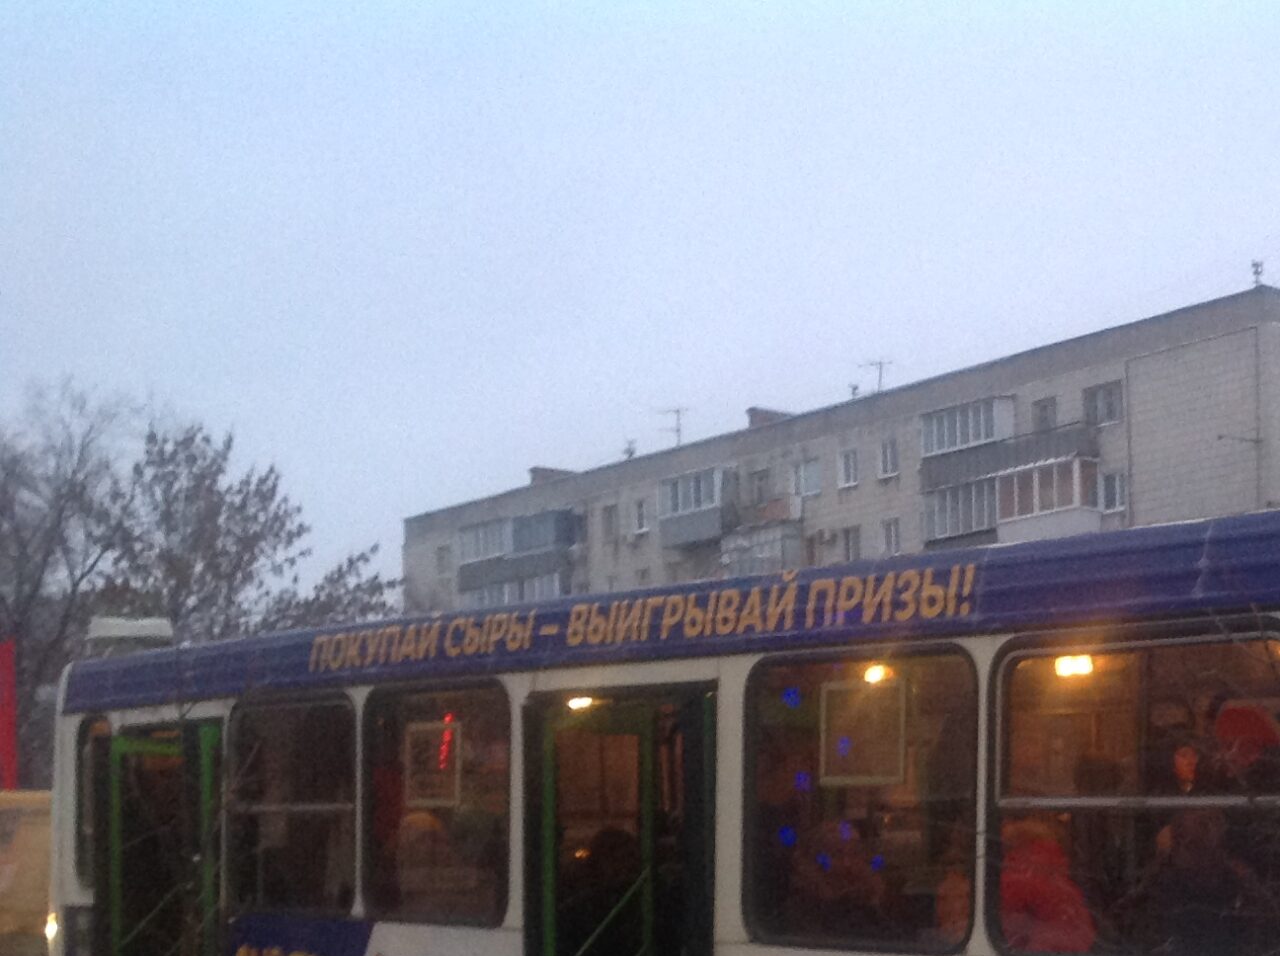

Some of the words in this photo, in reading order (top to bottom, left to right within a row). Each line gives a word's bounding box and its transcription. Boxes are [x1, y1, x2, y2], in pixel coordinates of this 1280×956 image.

[308, 611, 443, 673] ПОКУПАЙ
[445, 609, 537, 657] СЫРЫ
[565, 571, 798, 648] ВЫИГРЫВАЙ
[805, 563, 975, 630] ПРИЗЫ!
